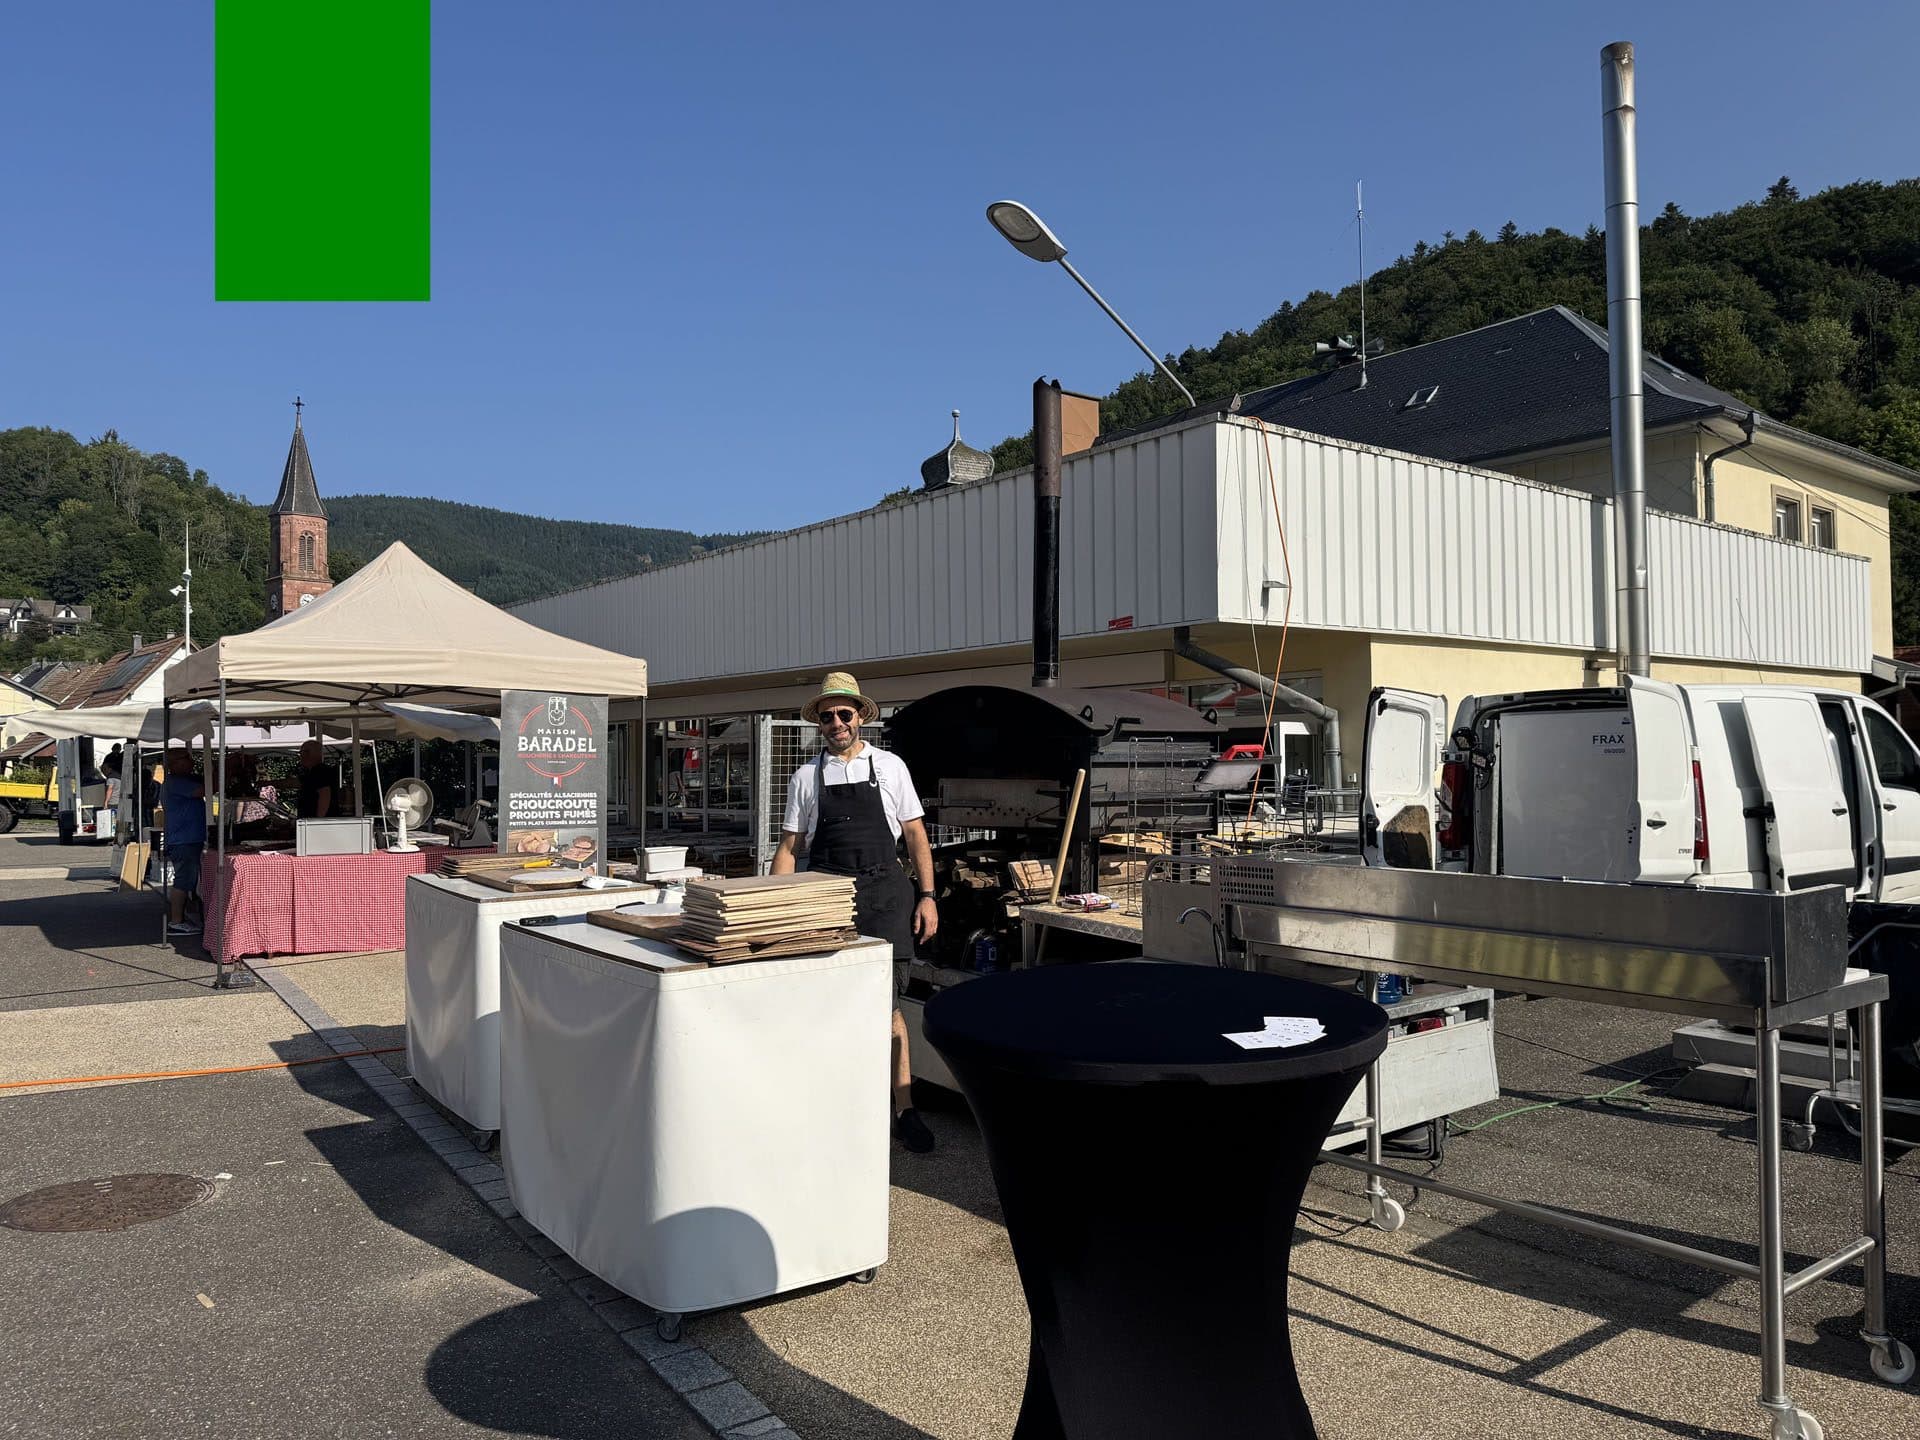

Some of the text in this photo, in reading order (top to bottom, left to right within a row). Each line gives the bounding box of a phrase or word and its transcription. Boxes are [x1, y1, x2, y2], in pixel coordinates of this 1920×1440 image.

[518, 736, 597, 752] BARADEL
[1592, 734, 1625, 744] FRAX
[509, 791, 552, 799] SPÉCIALITÉS
[509, 799, 598, 810] CHOUCROUTE
[509, 808, 598, 820] PRODUITS FUMÉS
